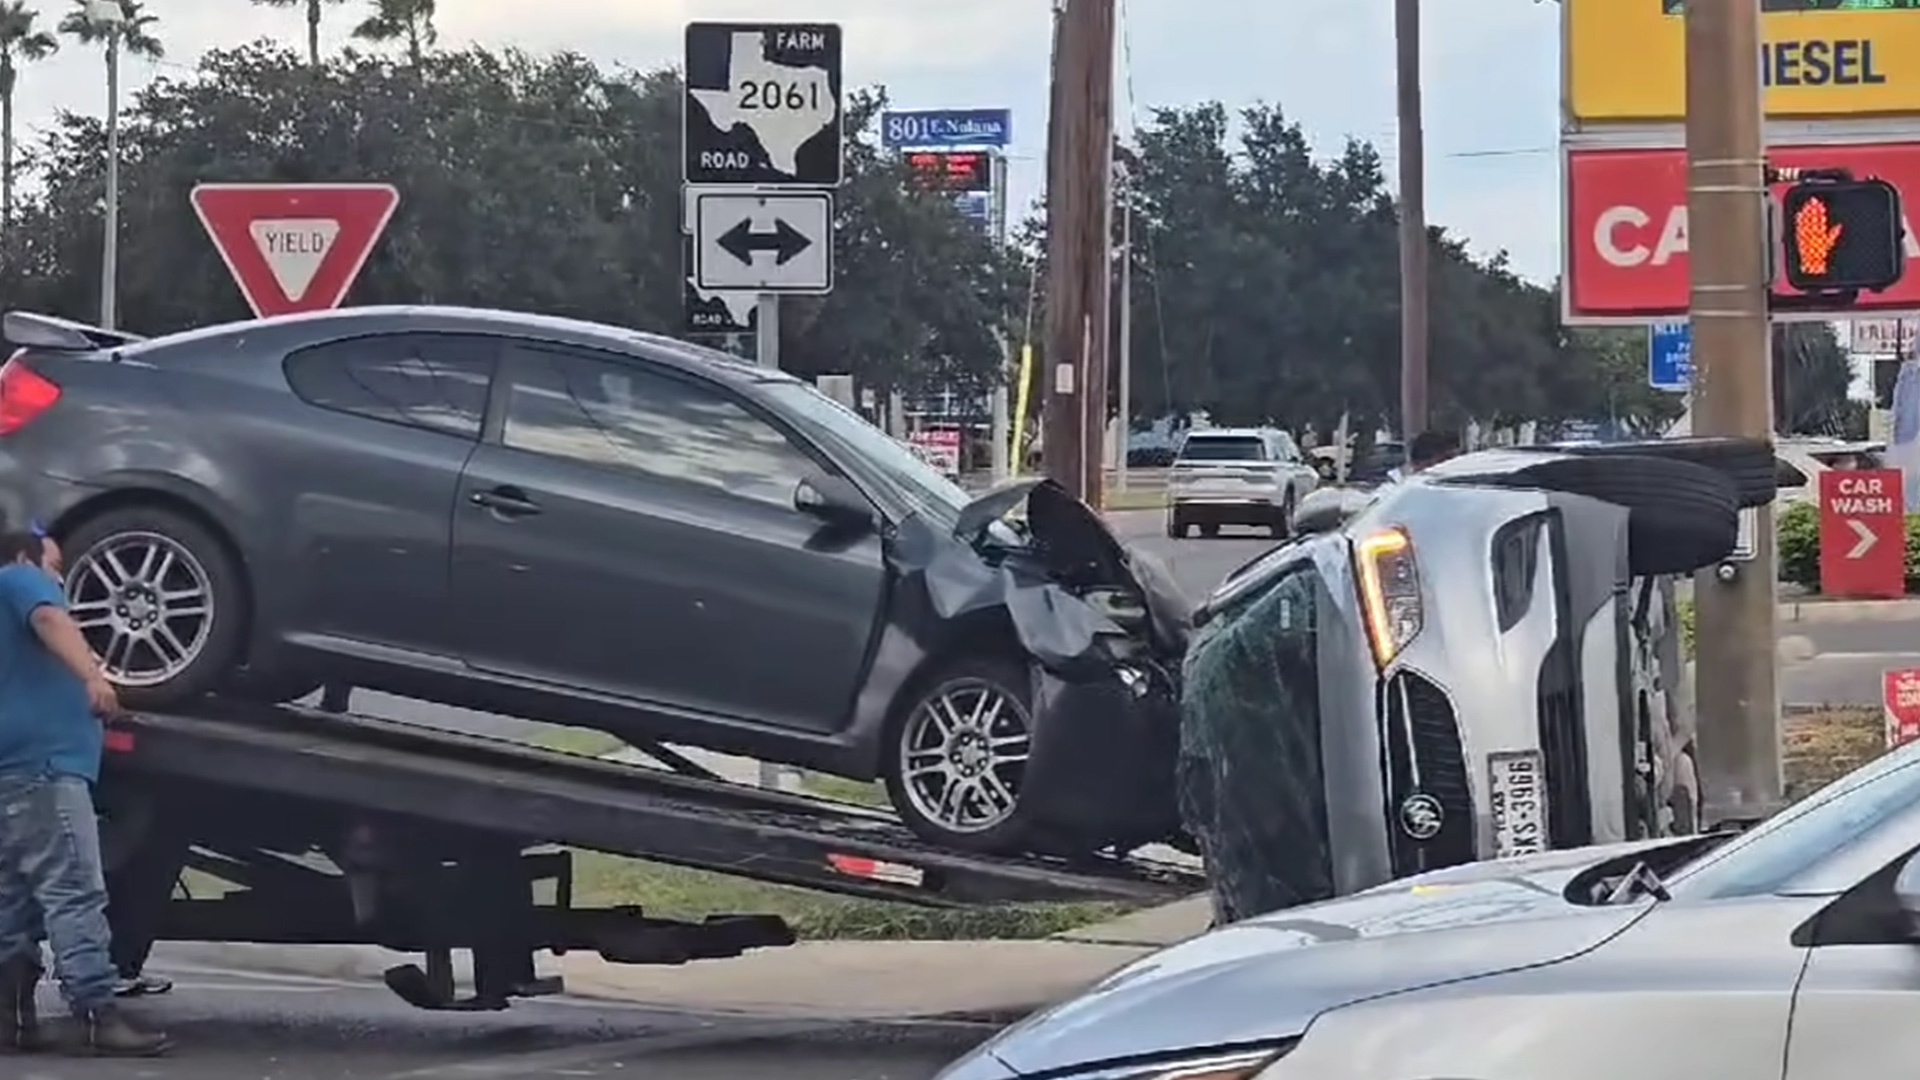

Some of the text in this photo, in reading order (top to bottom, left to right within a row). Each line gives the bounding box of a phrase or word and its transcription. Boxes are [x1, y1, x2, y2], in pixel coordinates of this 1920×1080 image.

[776, 31, 825, 50] FARM
[1761, 39, 1886, 87] IESEL
[738, 80, 818, 110] 2061
[888, 116, 930, 141] 801
[945, 119, 1002, 133] Nolana
[700, 150, 750, 169] ROAD
[265, 231, 324, 254] YIELD
[1593, 205, 1689, 267] CA
[1838, 478, 1883, 495] CAR
[1830, 497, 1893, 514] WASH
